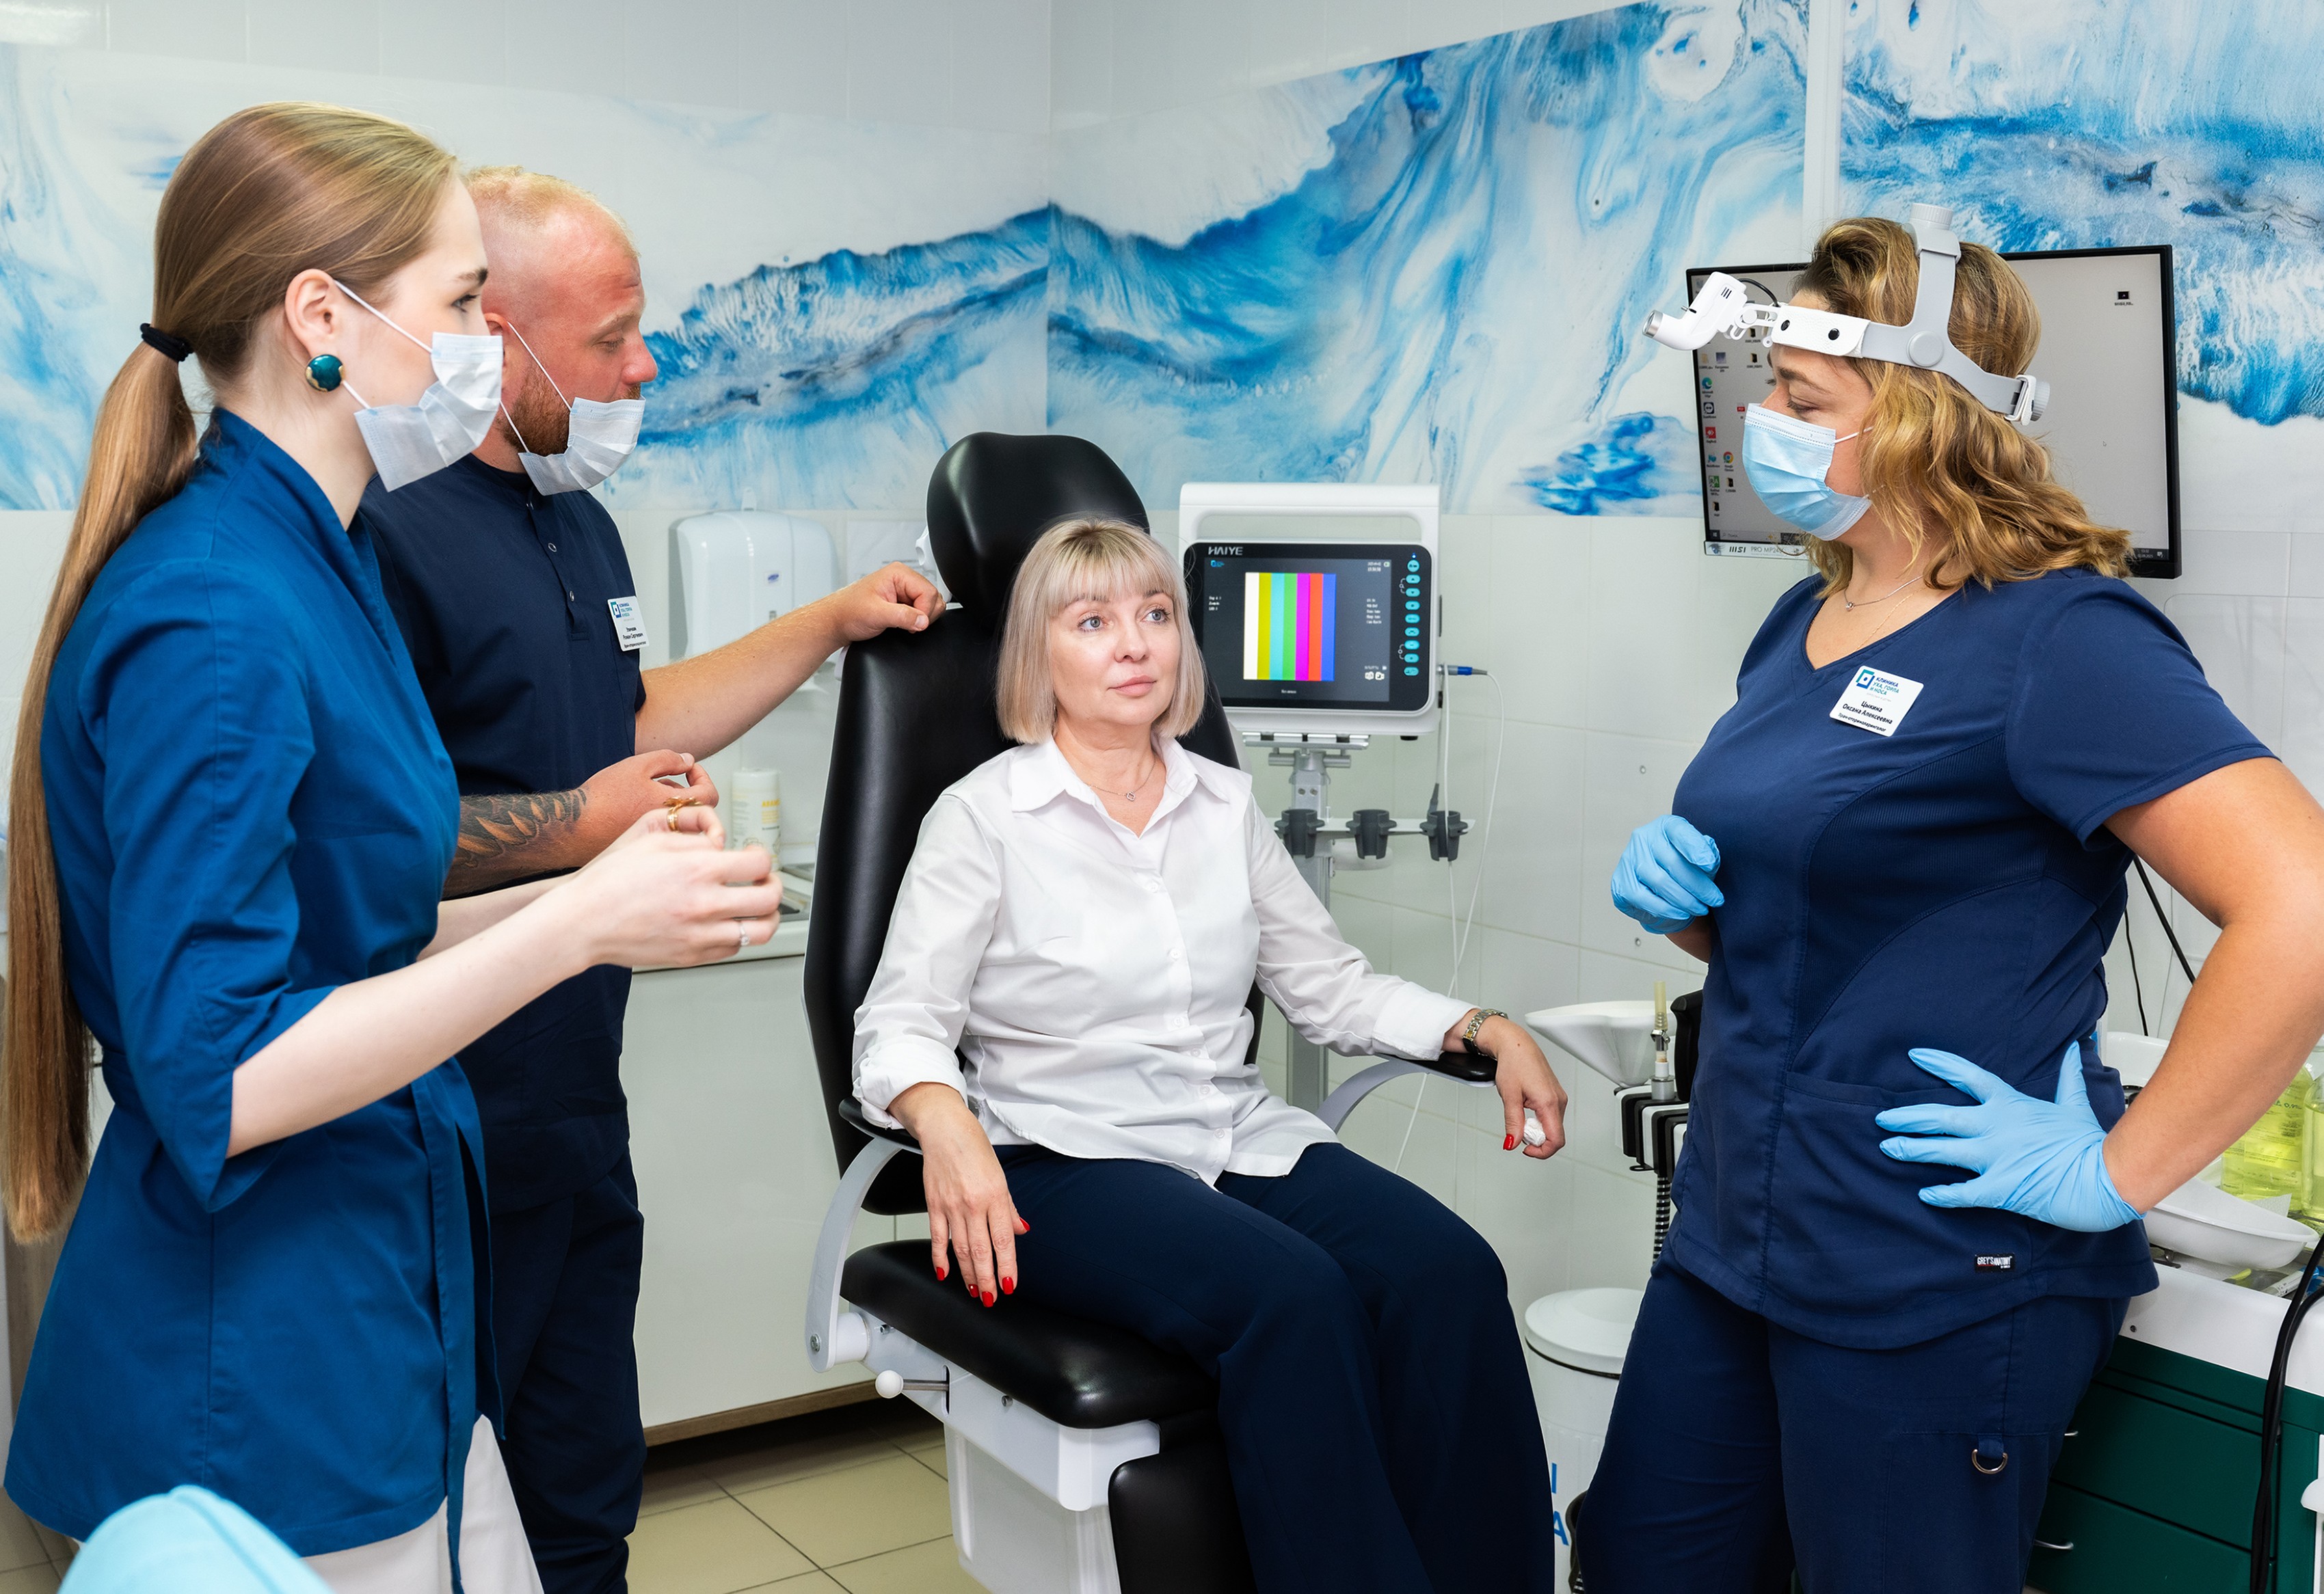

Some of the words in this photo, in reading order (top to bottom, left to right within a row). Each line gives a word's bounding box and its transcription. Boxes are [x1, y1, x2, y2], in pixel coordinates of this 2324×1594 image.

[1207, 546, 1244, 556] HAIYE
[1875, 677, 1899, 688] КЛИНИКА
[1884, 685, 1899, 693] ГОРЛА
[1860, 701, 1883, 712] Цыкина
[1842, 703, 1862, 714] Оксана
[1861, 710, 1893, 725] Алексеевна
[1977, 1256, 1994, 1265] GREY'S
